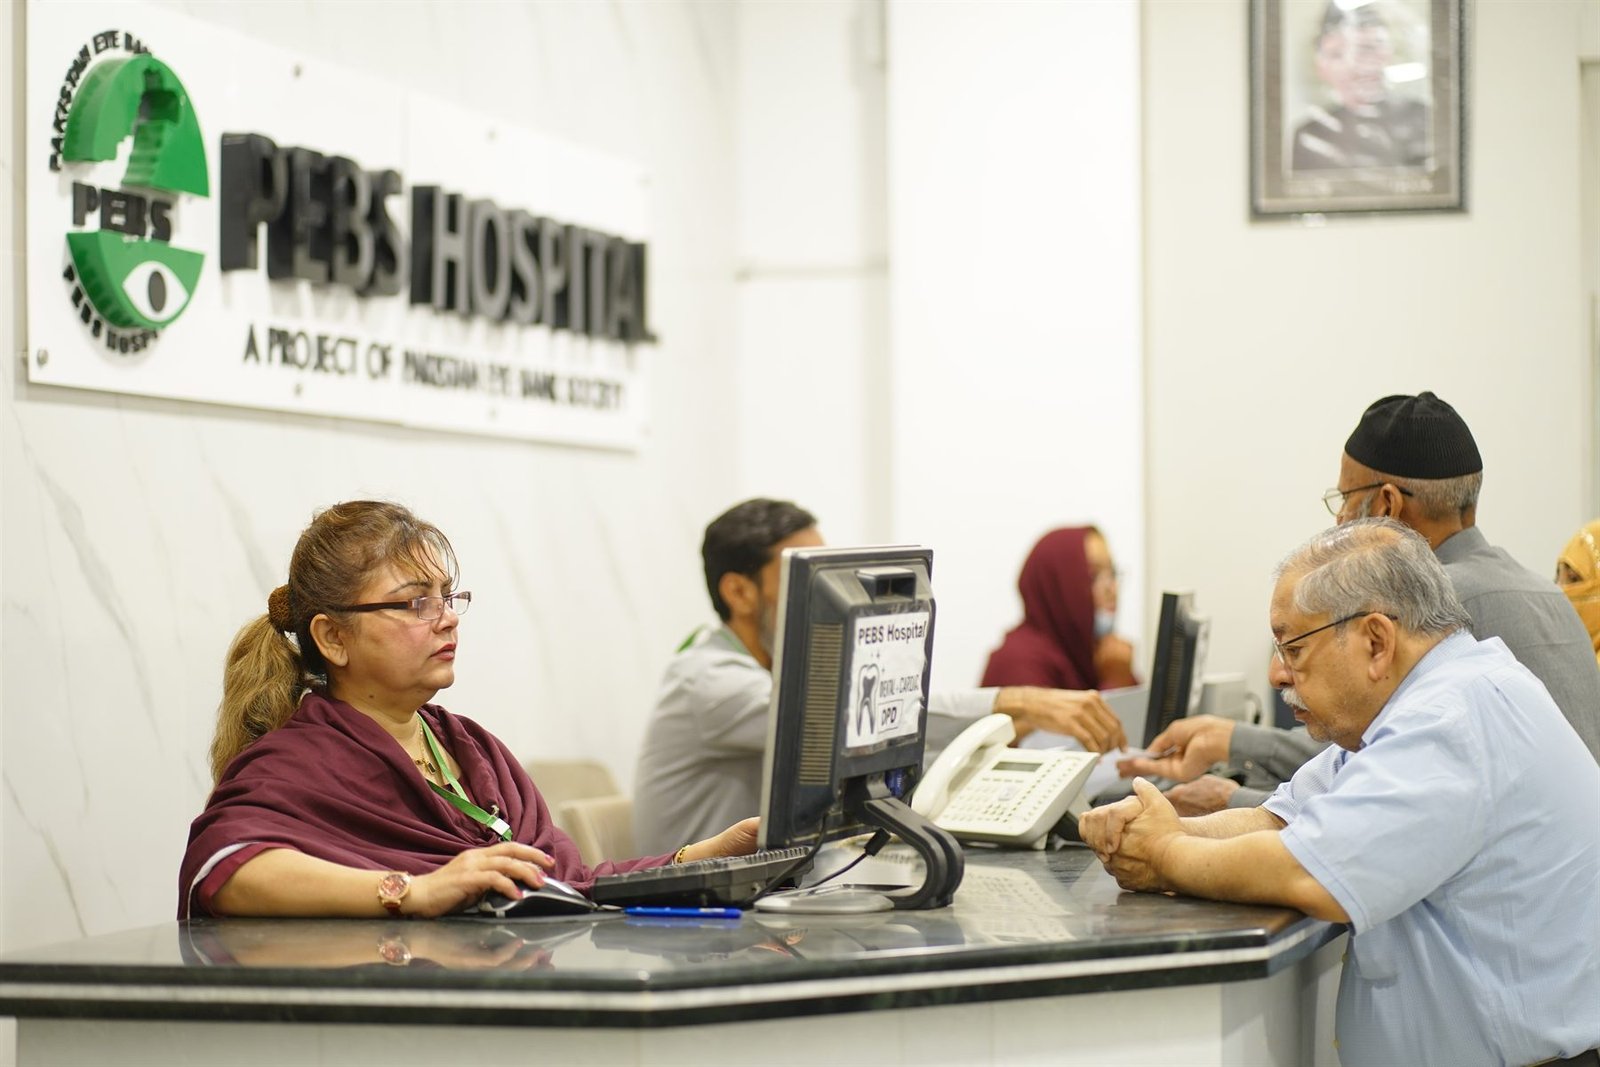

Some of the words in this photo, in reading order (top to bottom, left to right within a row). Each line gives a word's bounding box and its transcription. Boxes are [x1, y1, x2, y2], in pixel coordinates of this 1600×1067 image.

[72, 181, 173, 242] PEBS
[219, 132, 404, 298] PEBS
[410, 185, 659, 346] HOSPITAL
[243, 323, 261, 363] A
[267, 327, 360, 375] PROJECT
[366, 344, 394, 380] OF
[858, 626, 884, 645] PEBS
[887, 620, 928, 644] Hospital
